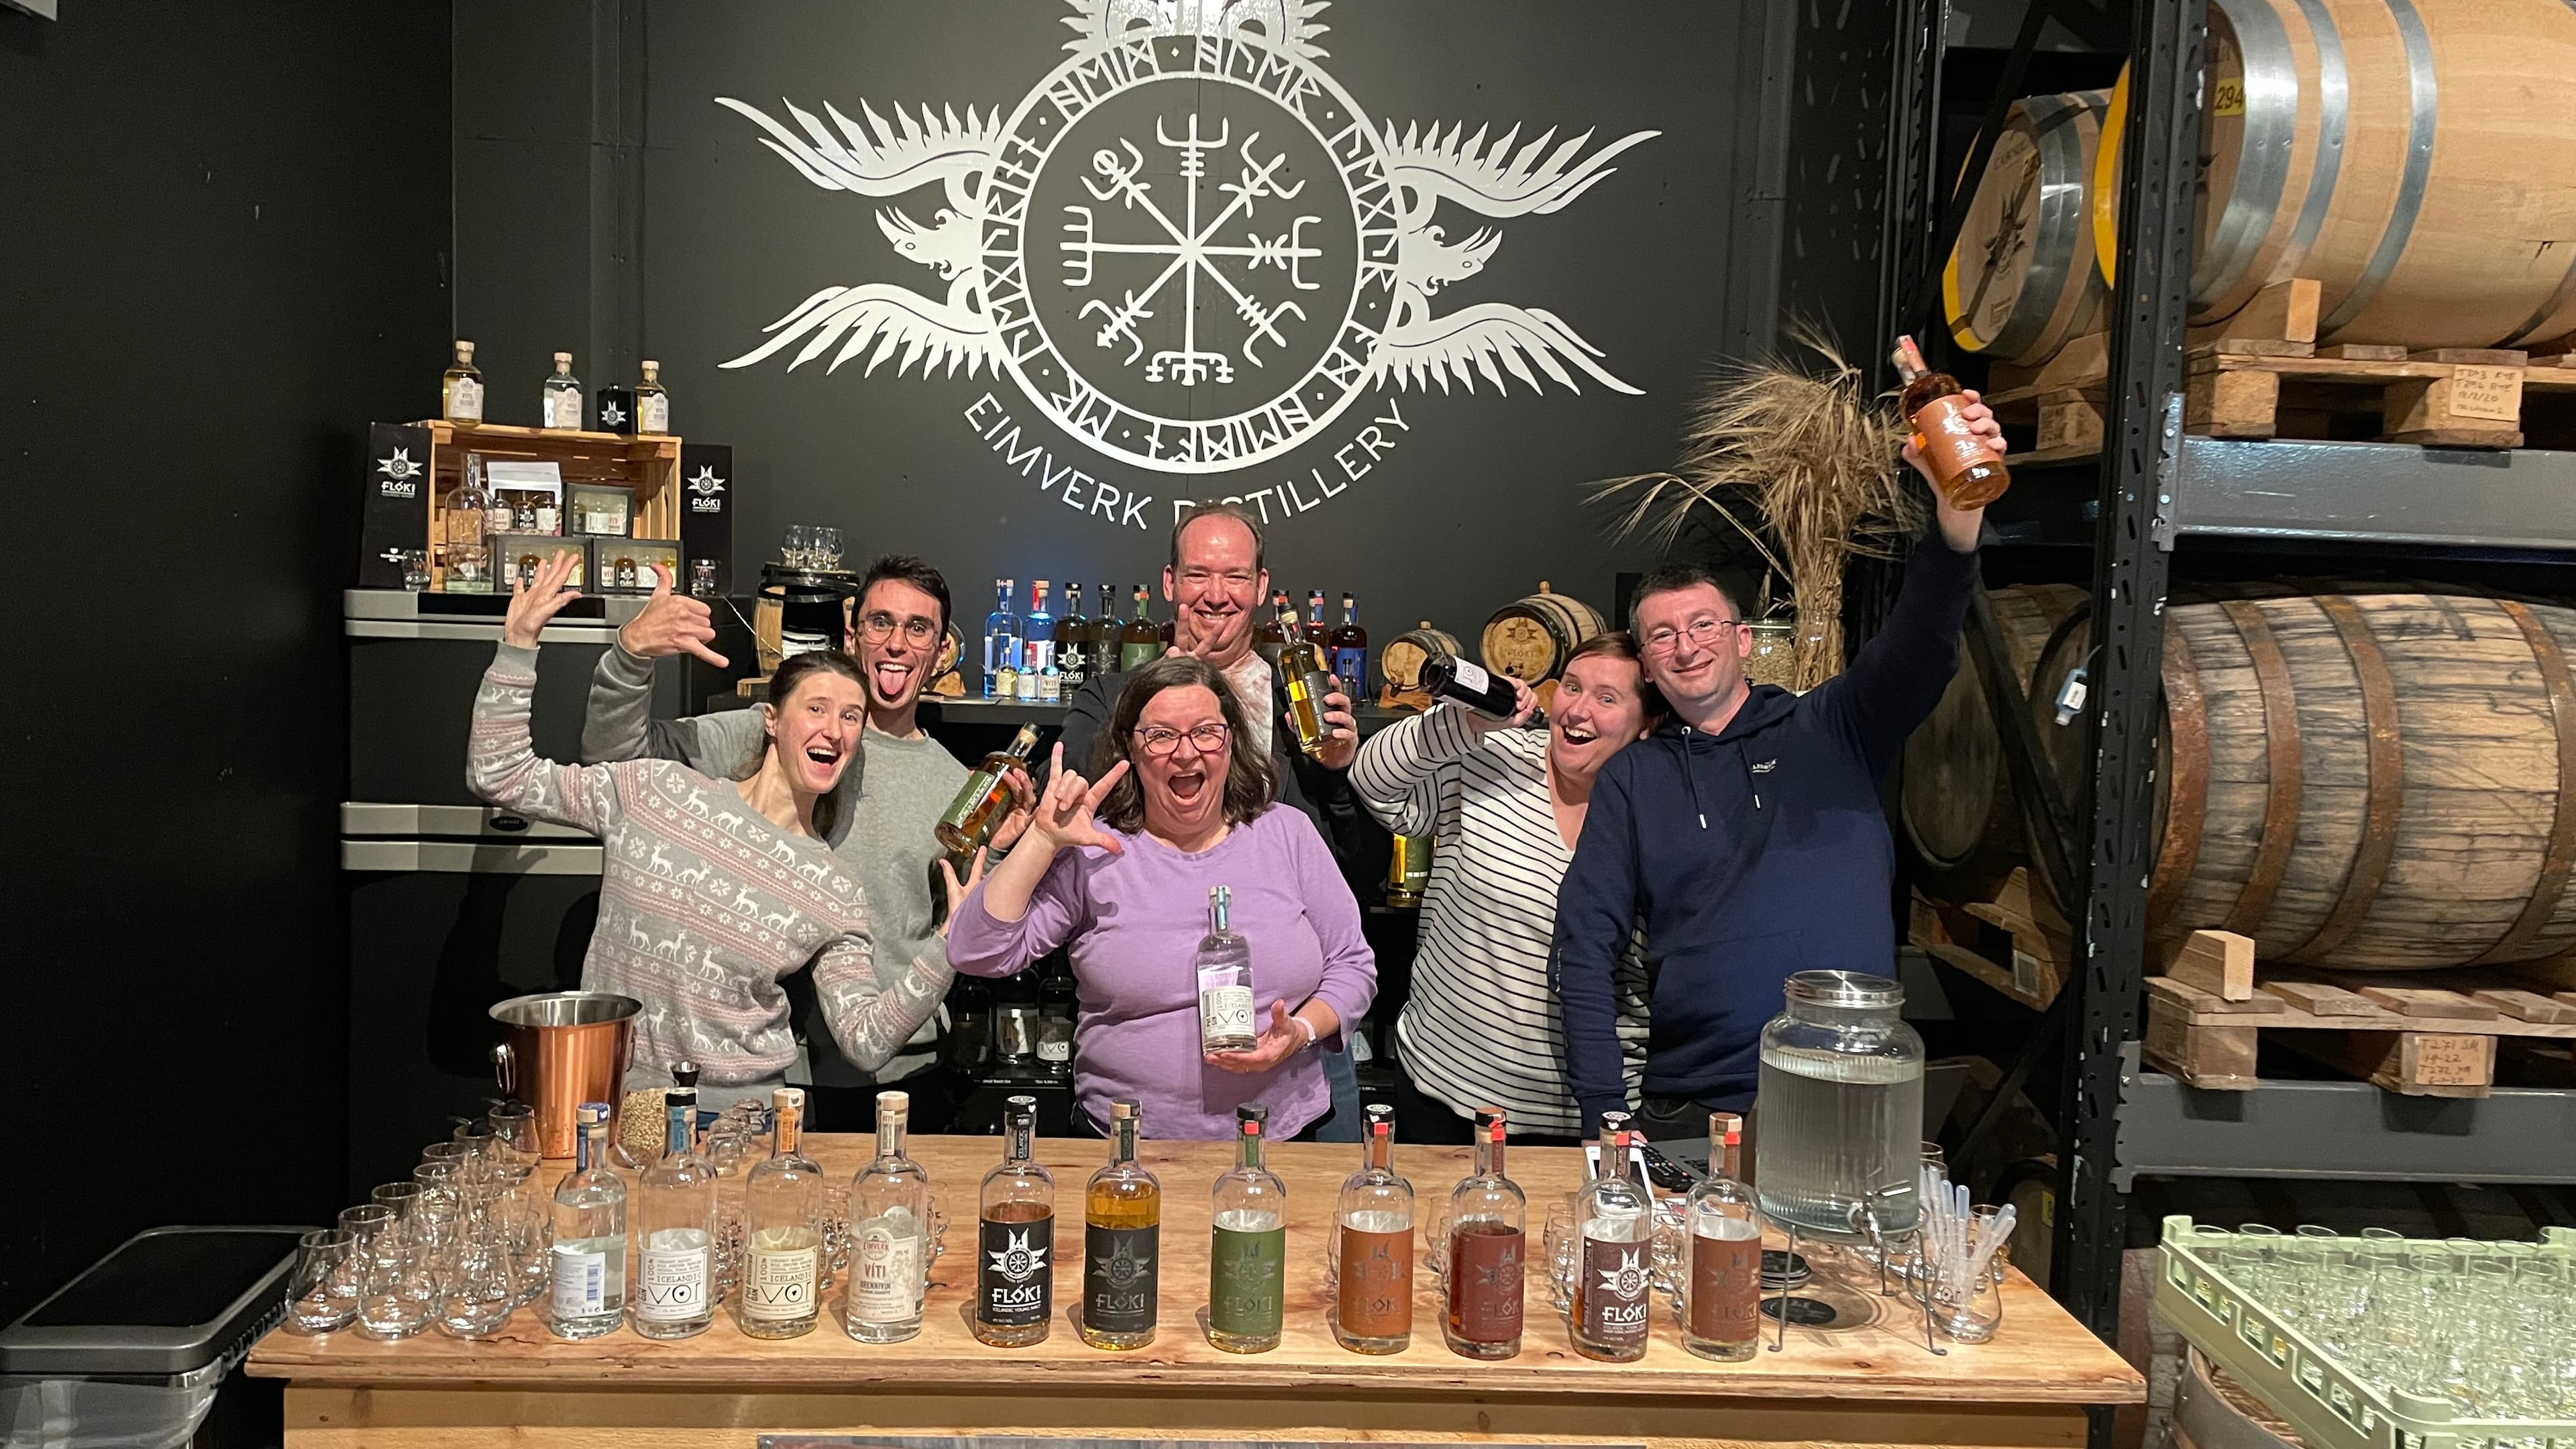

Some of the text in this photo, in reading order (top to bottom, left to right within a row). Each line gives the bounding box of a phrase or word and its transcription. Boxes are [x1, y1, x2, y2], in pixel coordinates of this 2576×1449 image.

[964, 392, 1409, 530] EIMVERK DTILLERY
[381, 480, 415, 492] FLÓKI
[692, 496, 720, 508] FLÓKI
[1059, 669, 1084, 681] FLÓKI
[770, 1271, 812, 1282] ICELANDIC
[864, 1262, 885, 1278] VÍTI
[657, 1272, 702, 1283] ICELANDIC
[991, 1284, 1041, 1303] FLÓKI
[1095, 1291, 1144, 1310] FLÓKI
[1602, 1303, 1647, 1322] FLÓKI
